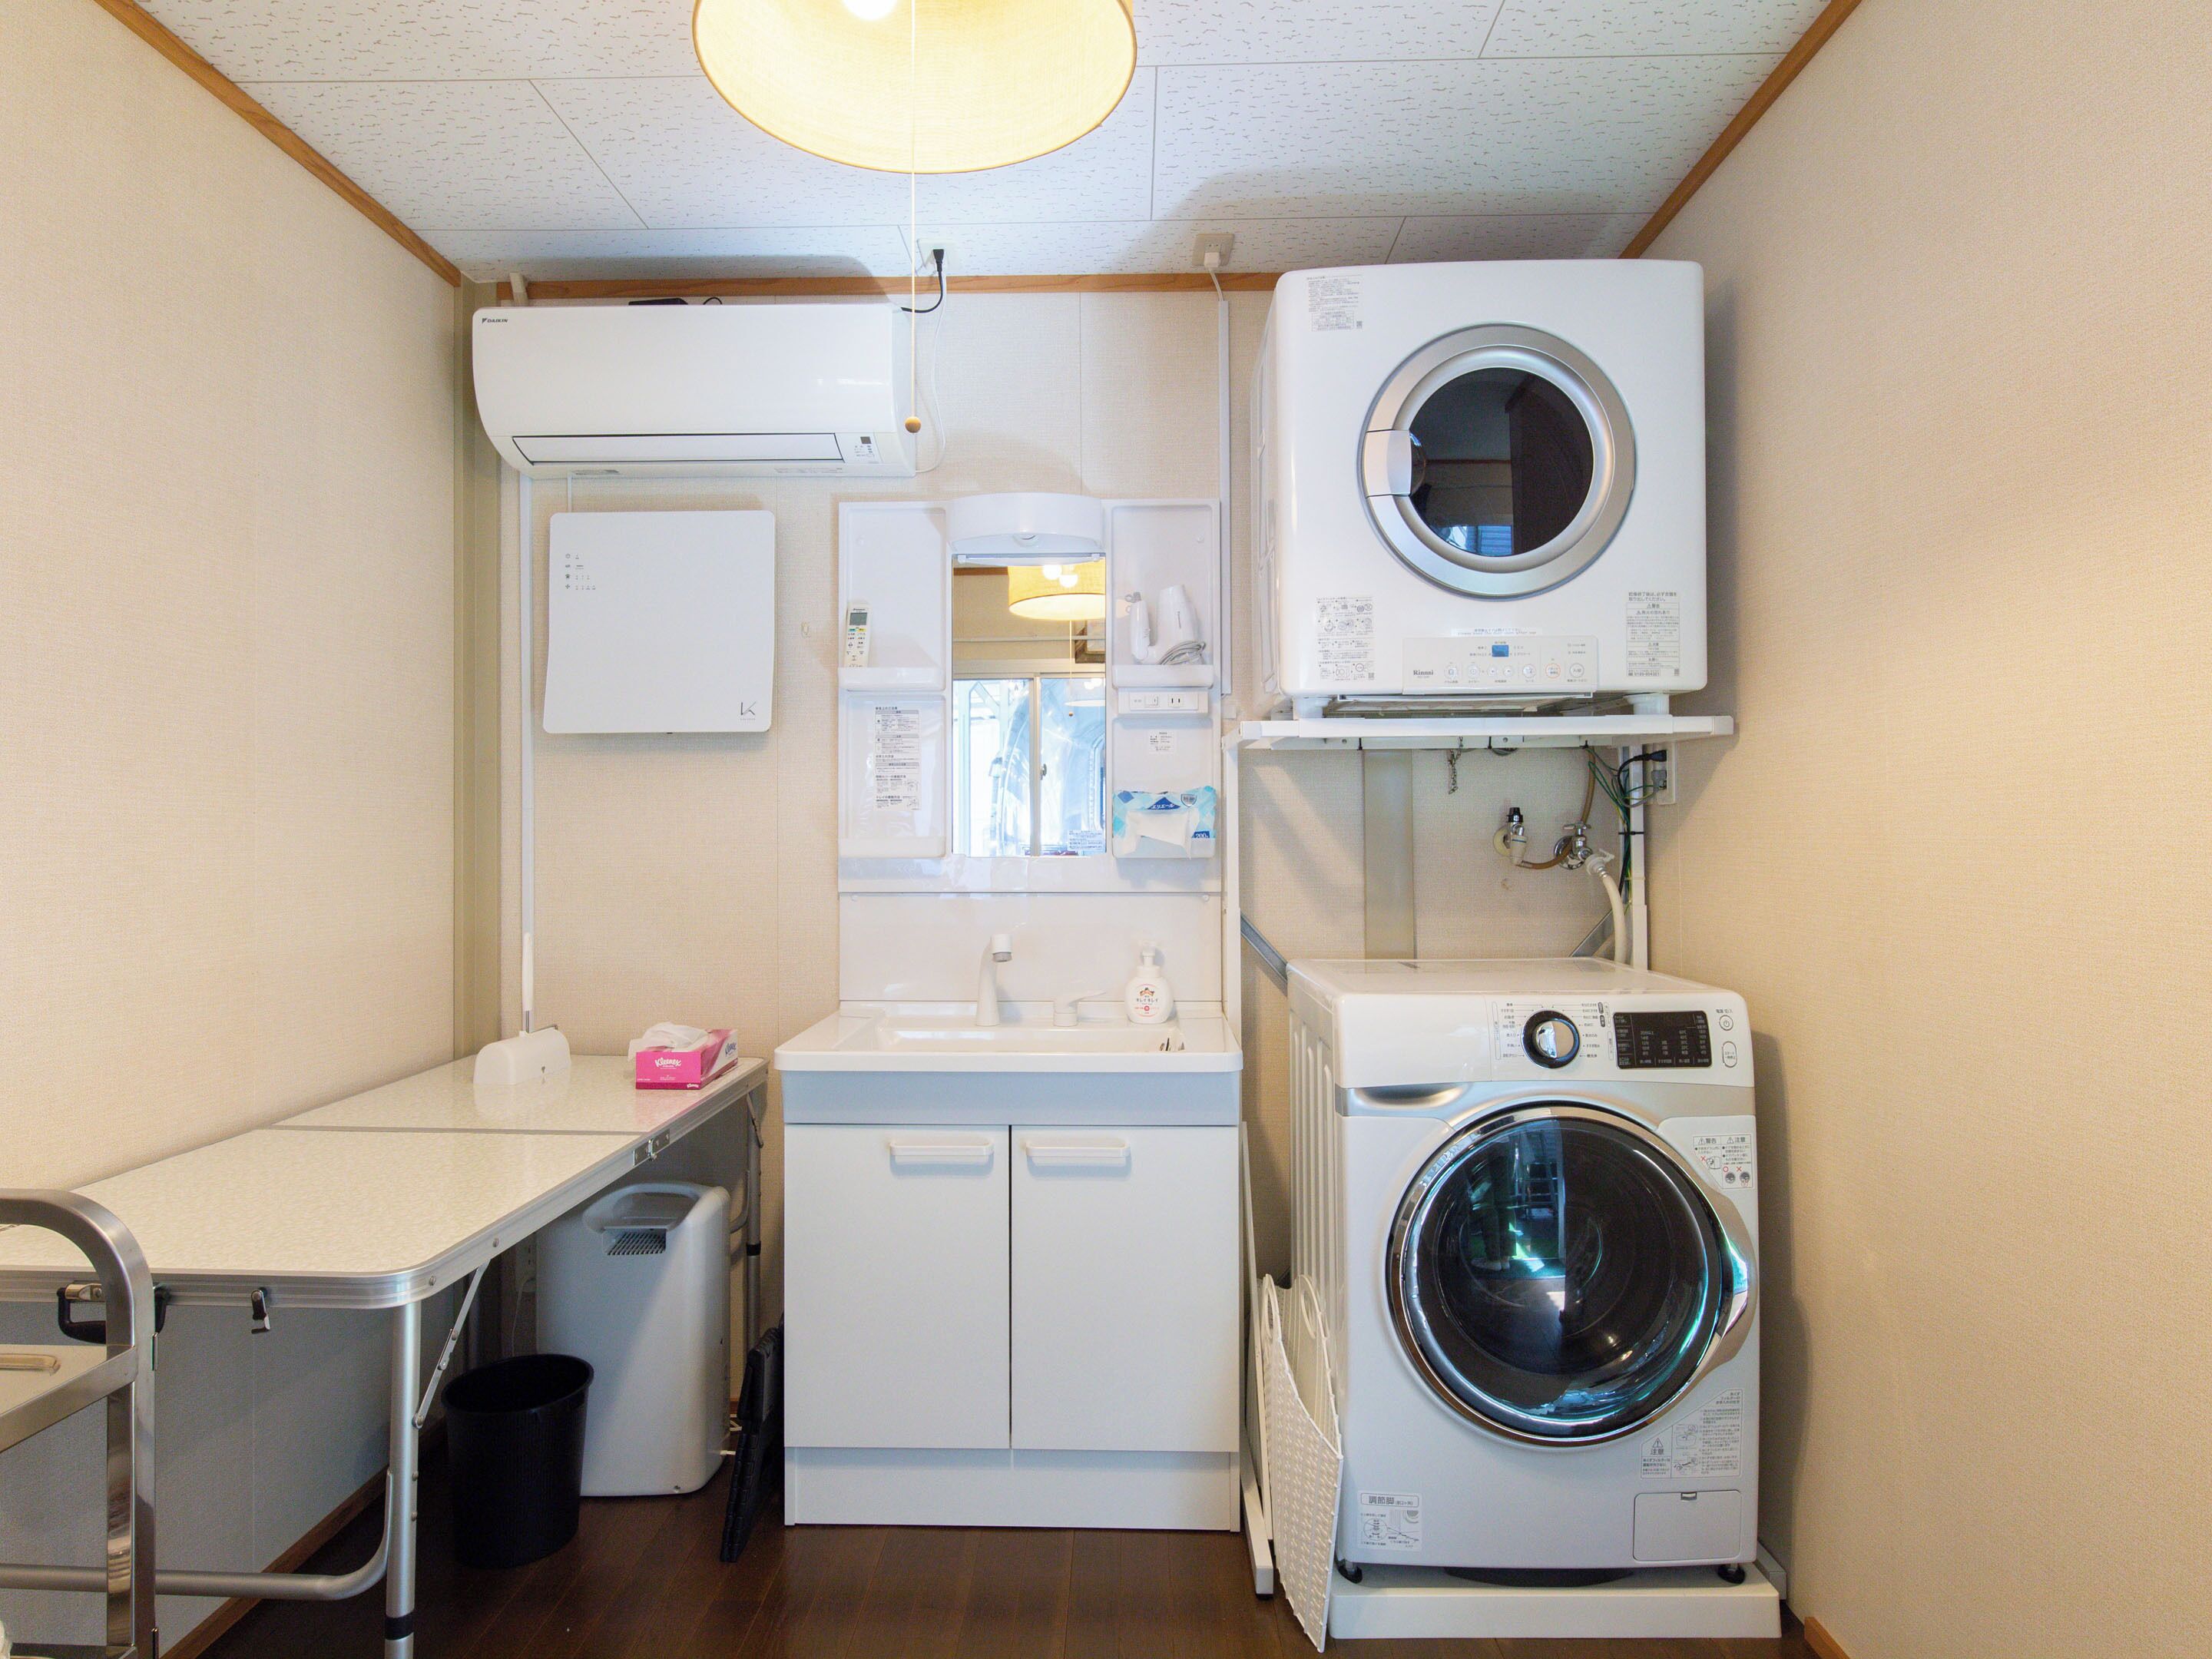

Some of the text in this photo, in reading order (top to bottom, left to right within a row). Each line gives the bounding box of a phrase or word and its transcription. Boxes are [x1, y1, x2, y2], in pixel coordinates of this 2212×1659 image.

[654, 1057, 682, 1068] Kleenex
[1369, 1495, 1395, 1505] 調節脚
